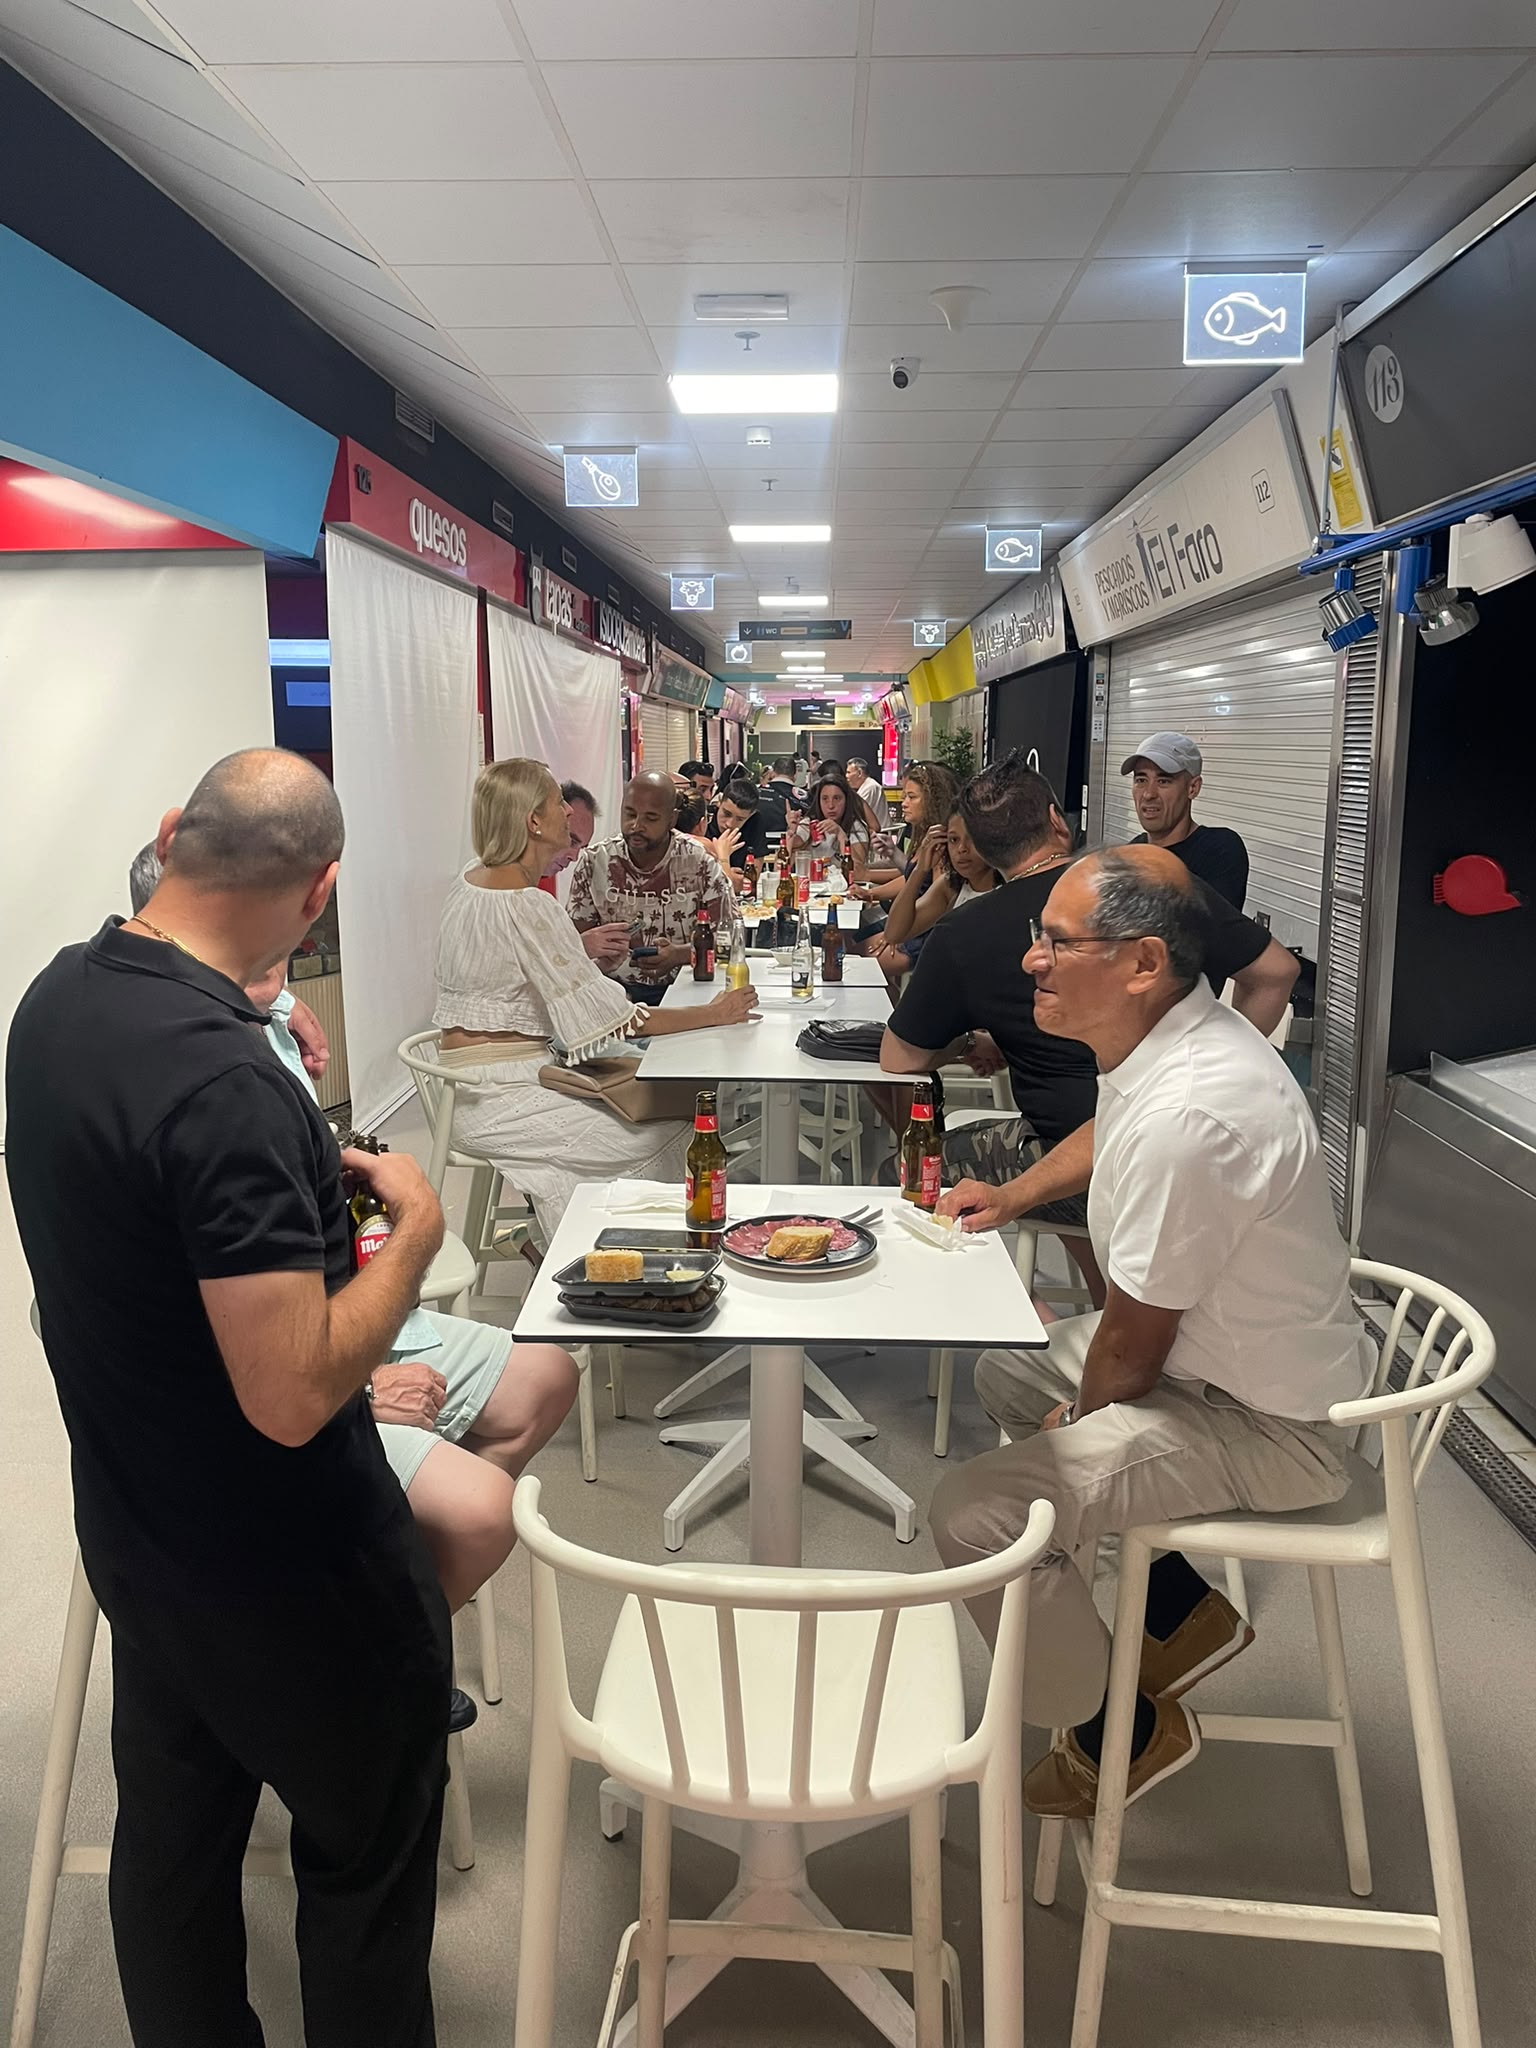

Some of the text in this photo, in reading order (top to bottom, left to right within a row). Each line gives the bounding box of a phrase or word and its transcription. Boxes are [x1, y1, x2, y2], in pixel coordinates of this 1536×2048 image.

[1369, 355, 1400, 413] 113
[1254, 480, 1271, 503] 112
[409, 498, 467, 567] quesos
[1167, 523, 1223, 590] Faro
[1095, 554, 1135, 596] PESCADOS
[545, 568, 572, 635] tapas
[1102, 599, 1111, 622] Y
[1107, 581, 1150, 620] MARISCOS
[605, 886, 688, 906] GUESS
